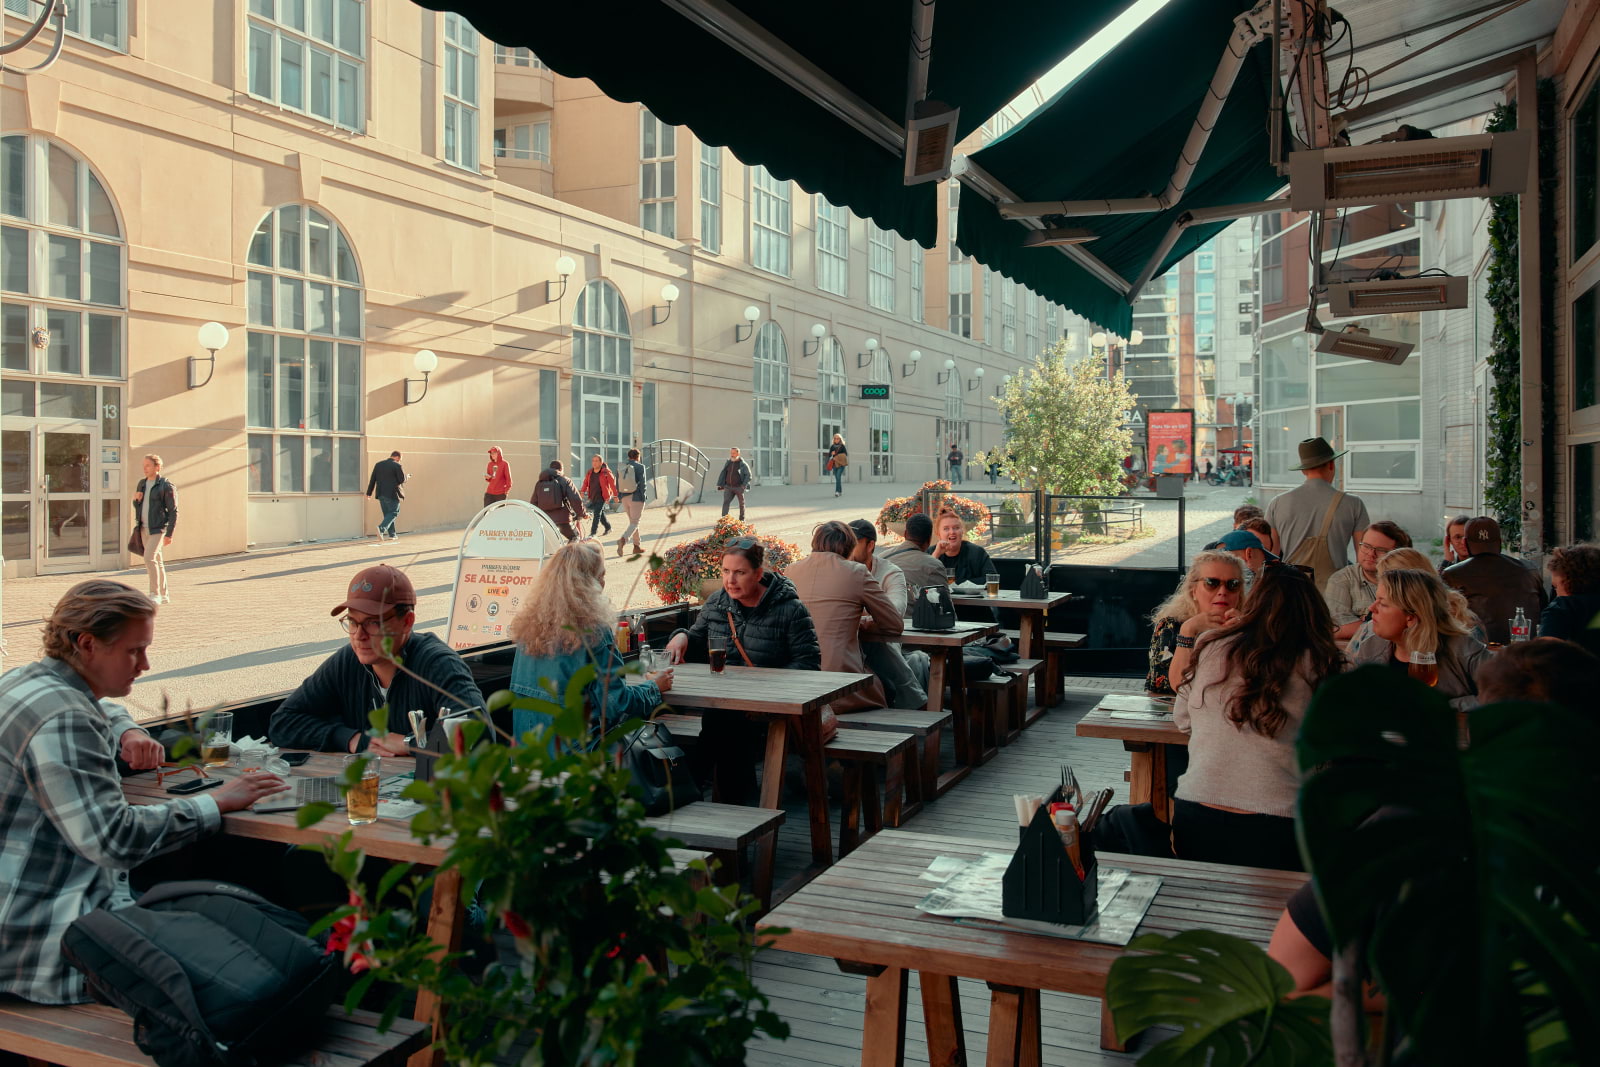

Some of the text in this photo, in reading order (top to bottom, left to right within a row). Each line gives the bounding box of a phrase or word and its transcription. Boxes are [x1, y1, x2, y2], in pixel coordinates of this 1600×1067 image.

[864, 387, 886, 396] coop
[103, 404, 117, 419] 13
[479, 529, 507, 537] PARKEN
[1479, 529, 1489, 540] NY
[464, 573, 533, 585] SE ALL SPORT
